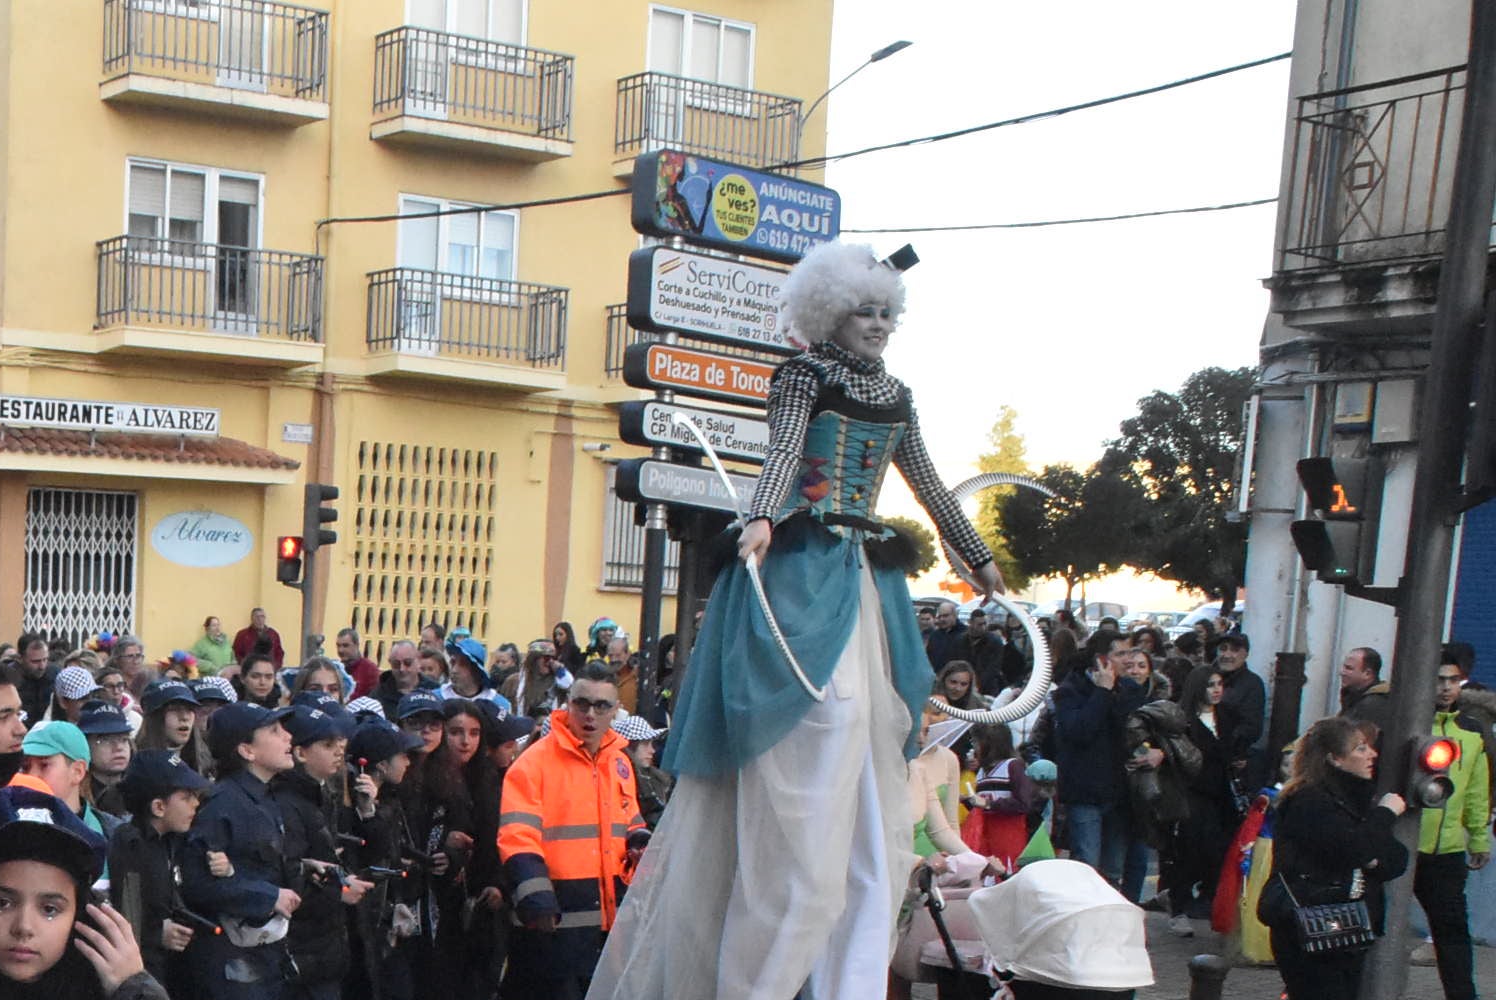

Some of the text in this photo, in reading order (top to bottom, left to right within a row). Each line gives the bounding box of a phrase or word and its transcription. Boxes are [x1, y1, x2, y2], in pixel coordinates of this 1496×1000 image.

[719, 181, 746, 197] ¿me
[759, 182, 833, 211] ANÚNCIATE
[727, 198, 756, 214] ves?
[761, 204, 832, 235] AQUÍ
[769, 229, 789, 250] 619
[687, 260, 780, 299] ServiCorte
[657, 280, 683, 295] Corte
[685, 288, 690, 296] a
[693, 287, 726, 303] Cuchillo
[729, 296, 735, 307] y
[736, 298, 741, 306] a
[659, 294, 761, 324] Deshuesado y Prensado
[655, 352, 771, 394] Plaza de Toros
[125, 408, 217, 432] ALVAREZ
[706, 418, 735, 434] Salud
[651, 423, 666, 437] CP.
[709, 432, 722, 446] de
[725, 435, 769, 453] Cervante
[161, 517, 243, 543] Alvarez
